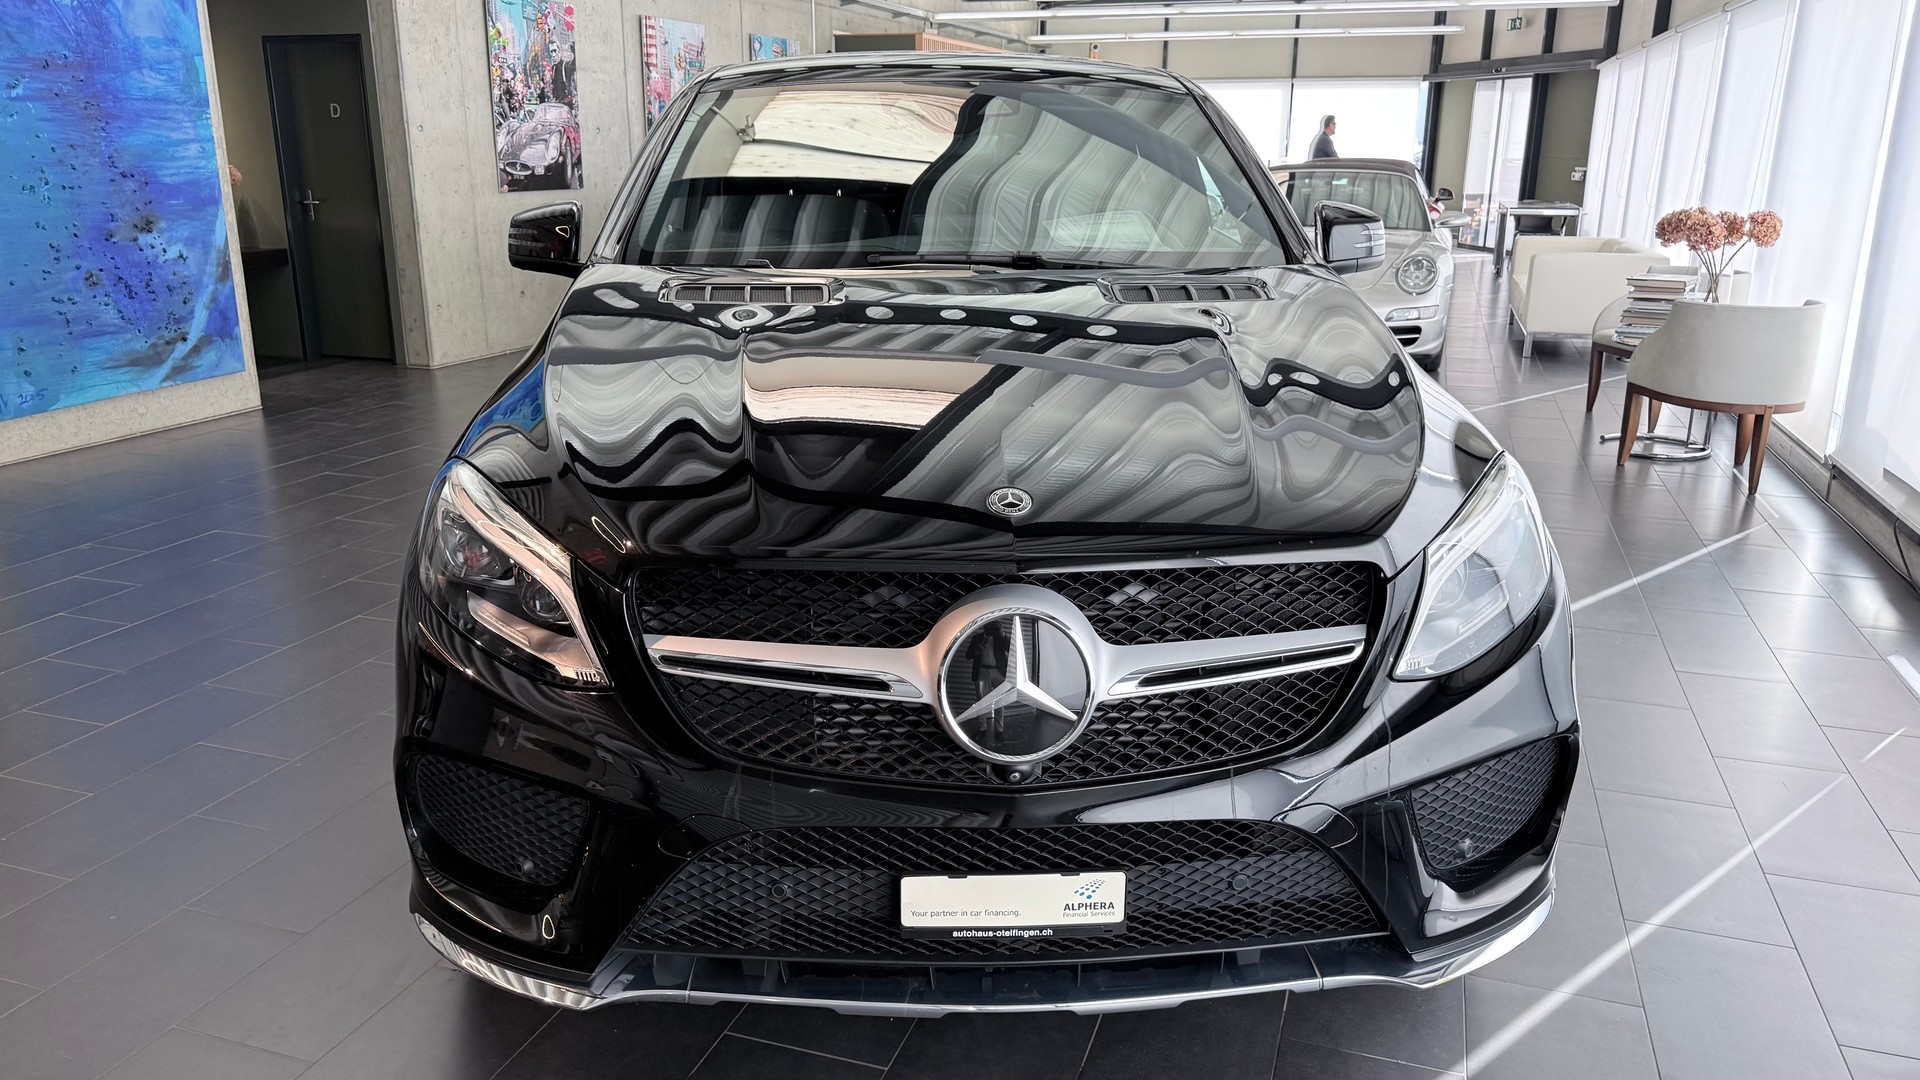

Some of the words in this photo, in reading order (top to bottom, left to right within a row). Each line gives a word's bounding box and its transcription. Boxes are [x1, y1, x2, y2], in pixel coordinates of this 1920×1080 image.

[330, 103, 340, 117] D
[1063, 901, 1115, 911] ALPHERA
[930, 910, 958, 918] partner
[984, 909, 1021, 917] financing.
[952, 928, 1053, 938] autohaus-otelfingen.ch
